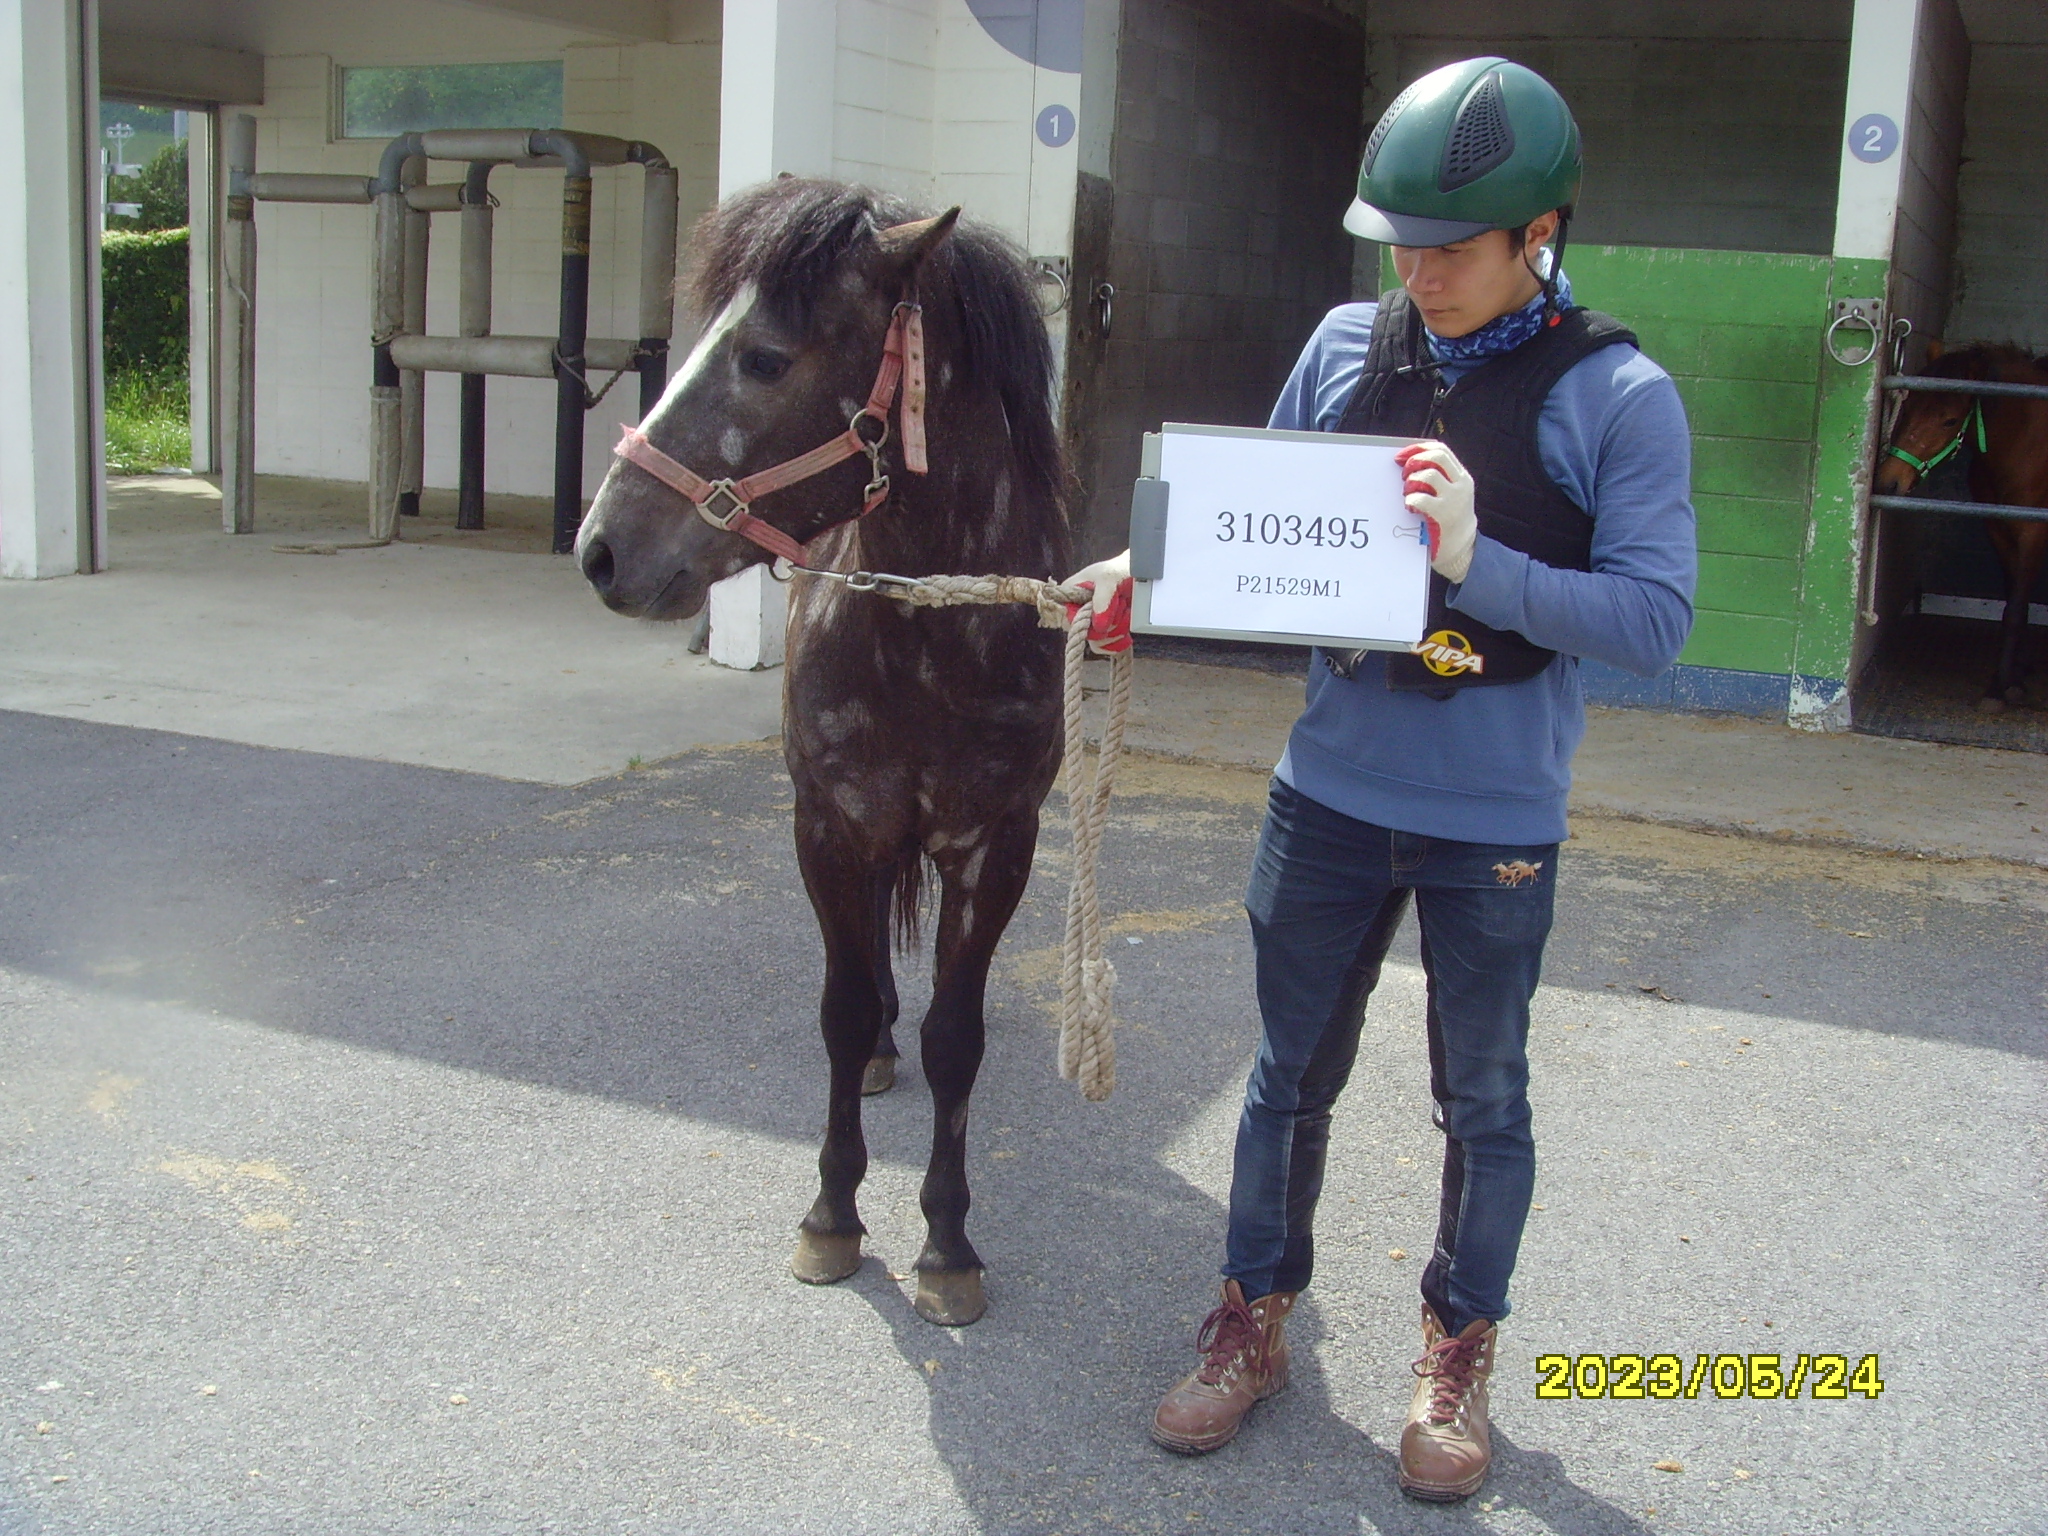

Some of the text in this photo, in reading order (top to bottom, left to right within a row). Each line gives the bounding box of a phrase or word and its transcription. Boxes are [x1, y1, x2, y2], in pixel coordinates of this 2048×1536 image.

[1049, 114, 1059, 138] 1
[1863, 125, 1883, 152] 2
[1216, 511, 1370, 549] 3103495
[1236, 575, 1342, 598] P21529M1
[1409, 641, 1484, 674] VIPA
